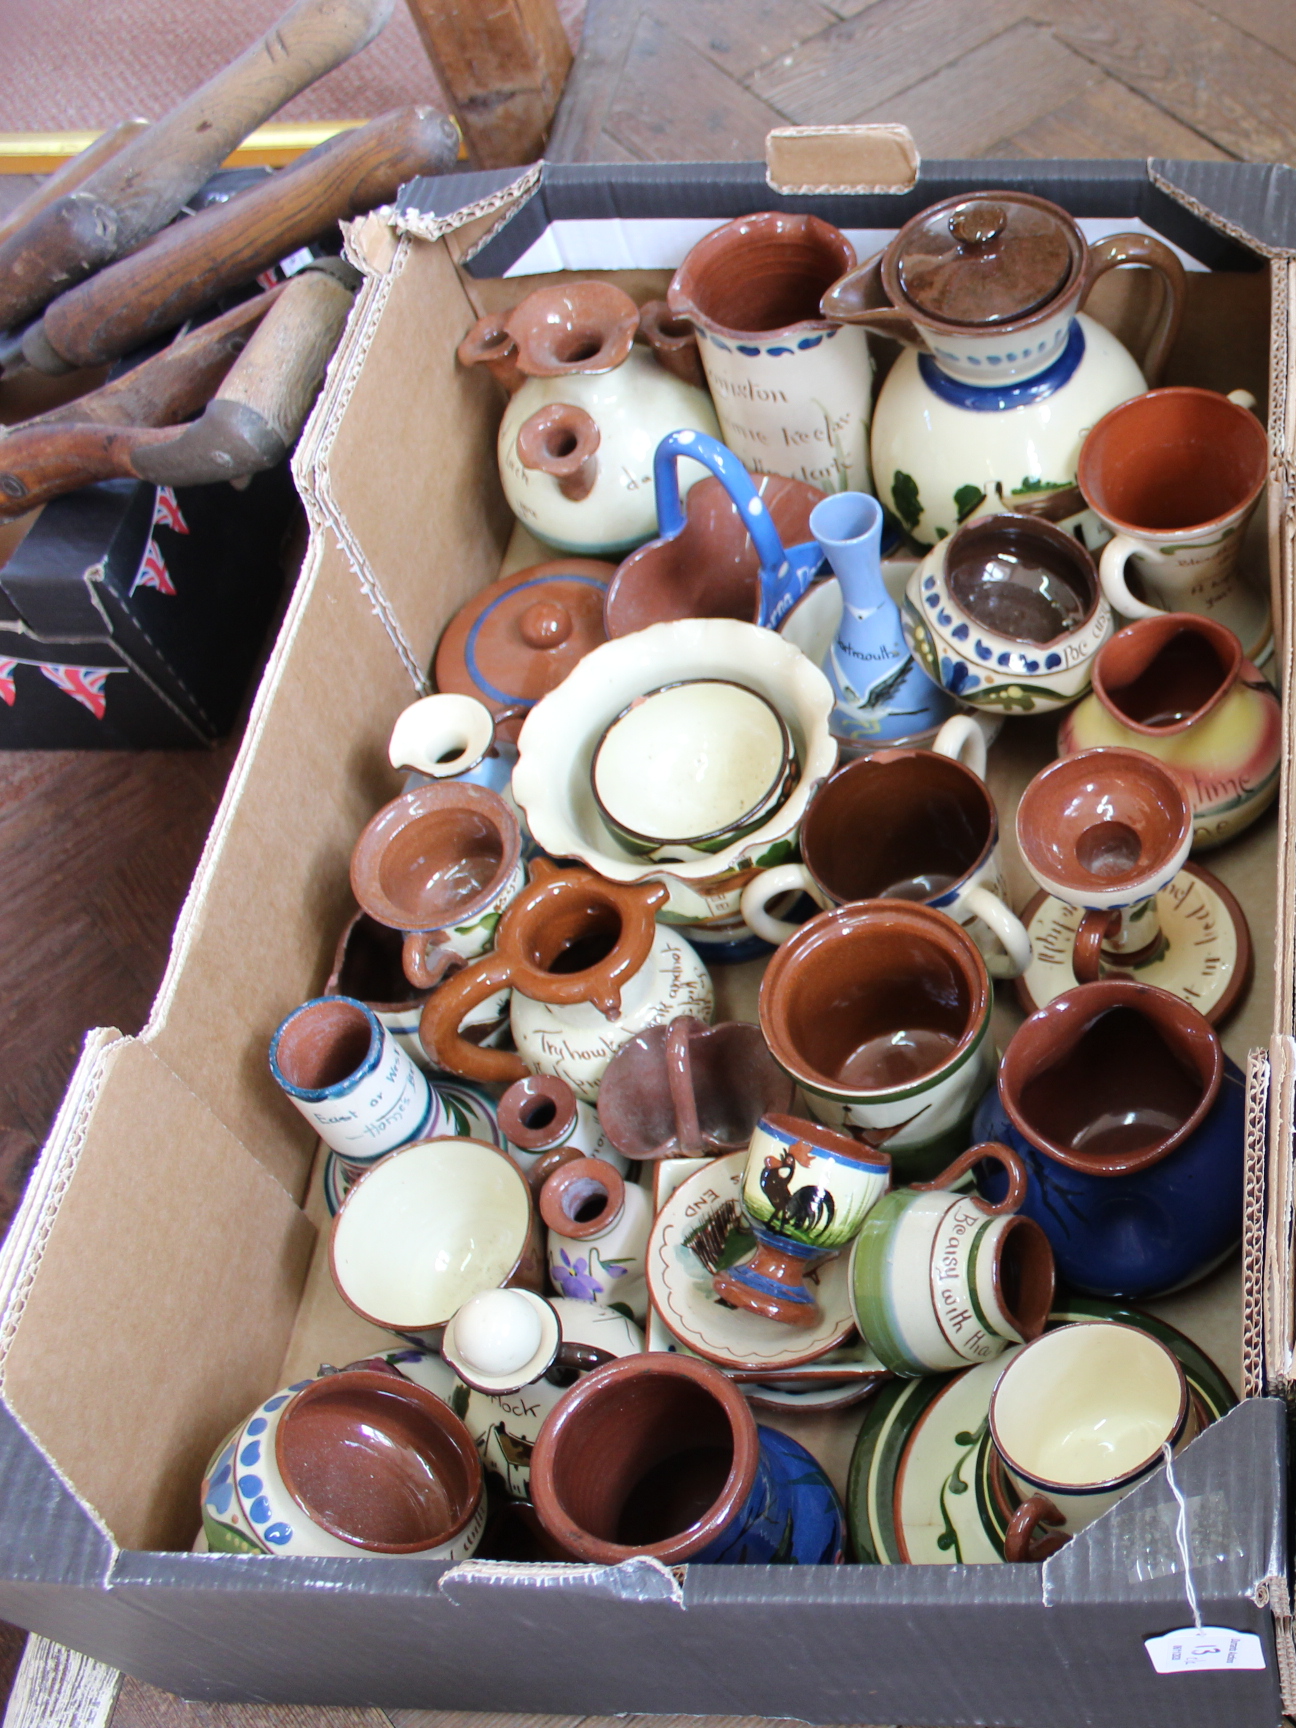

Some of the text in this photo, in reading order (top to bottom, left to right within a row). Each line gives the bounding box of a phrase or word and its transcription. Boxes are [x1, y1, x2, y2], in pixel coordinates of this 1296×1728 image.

[314, 1110, 359, 1125] East
[369, 1091, 384, 1108] or
[685, 1189, 720, 1218] END
[940, 1288, 973, 1335] with
[1191, 1644, 1221, 1656] 13
